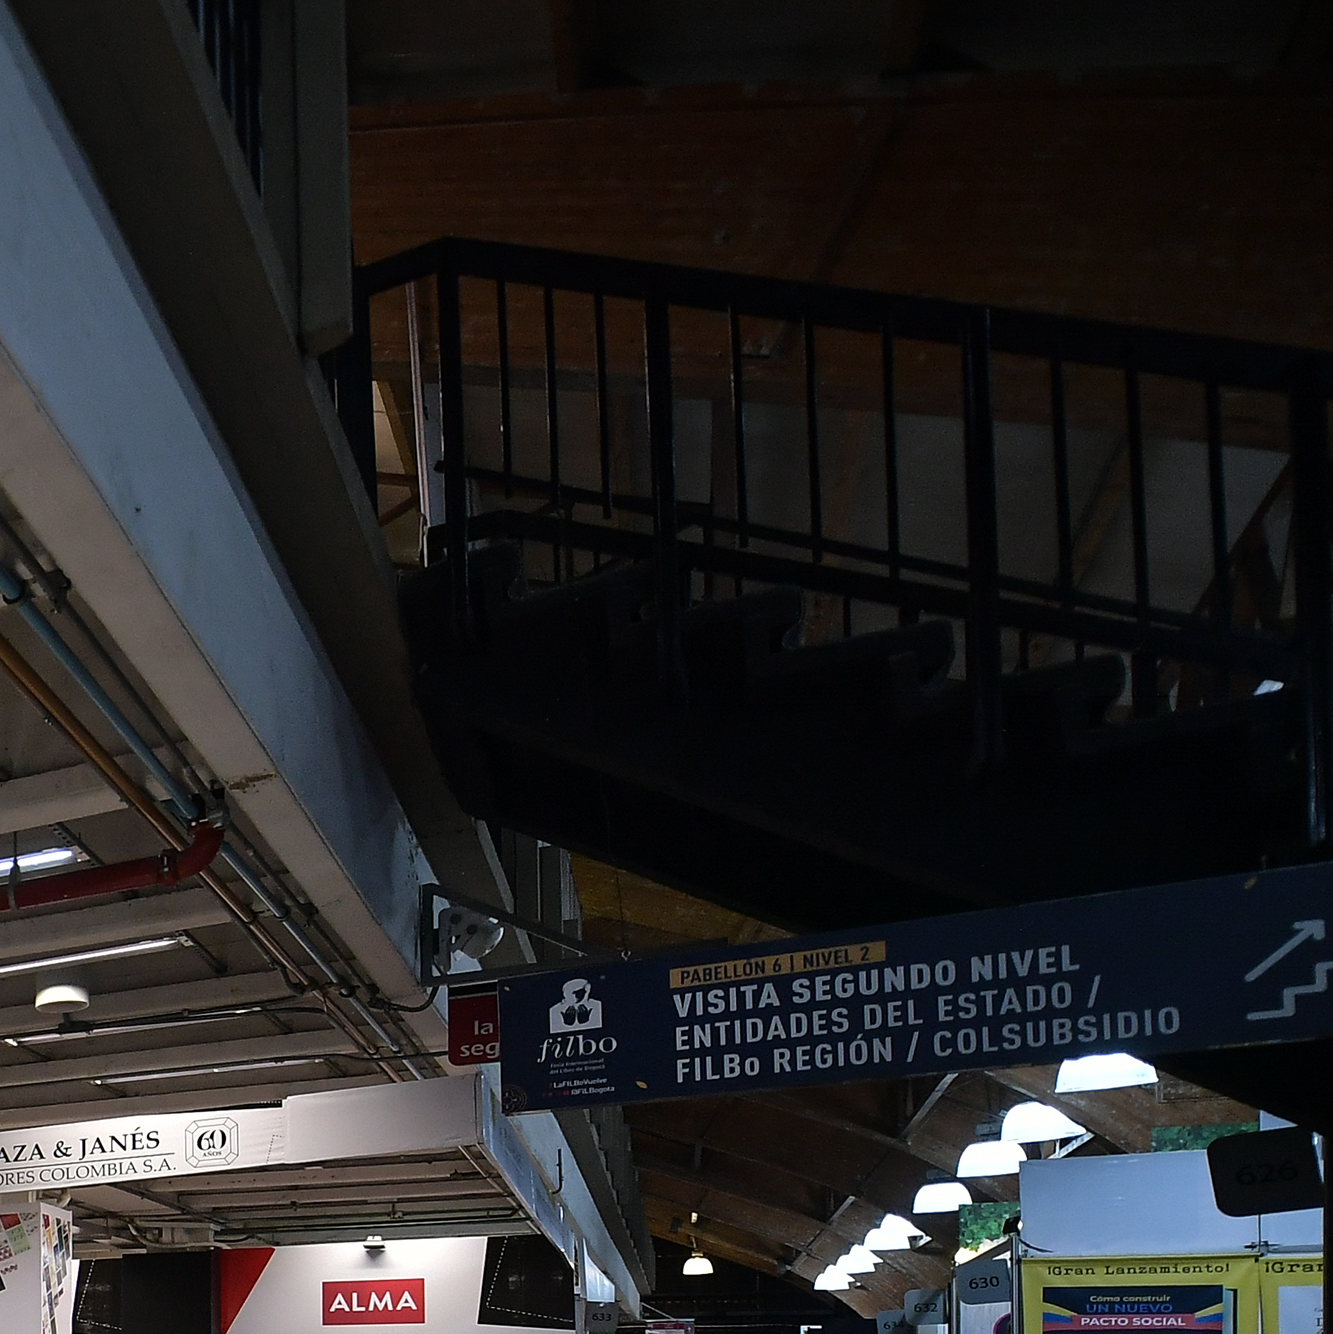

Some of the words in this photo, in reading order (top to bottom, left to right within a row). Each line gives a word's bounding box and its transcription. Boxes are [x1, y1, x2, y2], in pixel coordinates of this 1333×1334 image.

[680, 958, 766, 985] PABELLÓN
[772, 958, 782, 973] 6
[803, 949, 852, 970] NIVEL
[861, 946, 870, 961] 2
[673, 982, 781, 1018] VISITA
[791, 959, 956, 1005] SEGUNDO
[971, 945, 1080, 983] NIVEL
[675, 1007, 849, 1051] ENTIDADES
[864, 999, 924, 1030] DEL
[938, 982, 1073, 1022] ESTADO
[1087, 974, 1102, 1009] /
[472, 1019, 493, 1035] la
[459, 1041, 500, 1062] seg
[536, 1034, 618, 1064] filbo
[676, 1053, 760, 1084] FILBo
[773, 1033, 893, 1074] REGIÓN
[906, 1031, 920, 1063] /
[933, 1006, 1180, 1058] COLSUBSIDIO
[53, 1141, 73, 1159] &
[78, 1127, 161, 1161] JANÉS
[39, 1161, 135, 1183] COLOMBIA
[143, 1158, 177, 1174] S.A.
[1104, 1262, 1230, 1275] Lanzamiento!
[968, 1275, 1000, 1290] 630
[329, 1290, 418, 1313] ALMA
[1089, 1294, 1120, 1303] Cómo
[1123, 1293, 1171, 1302] construir
[913, 1302, 938, 1313] 632
[1086, 1303, 1111, 1313] UN
[1115, 1303, 1173, 1313] NUEVO
[592, 1311, 613, 1323] 633
[883, 1320, 905, 1330] 634
[1080, 1317, 1129, 1326] PACTO
[1133, 1316, 1186, 1326] SOCIAL
